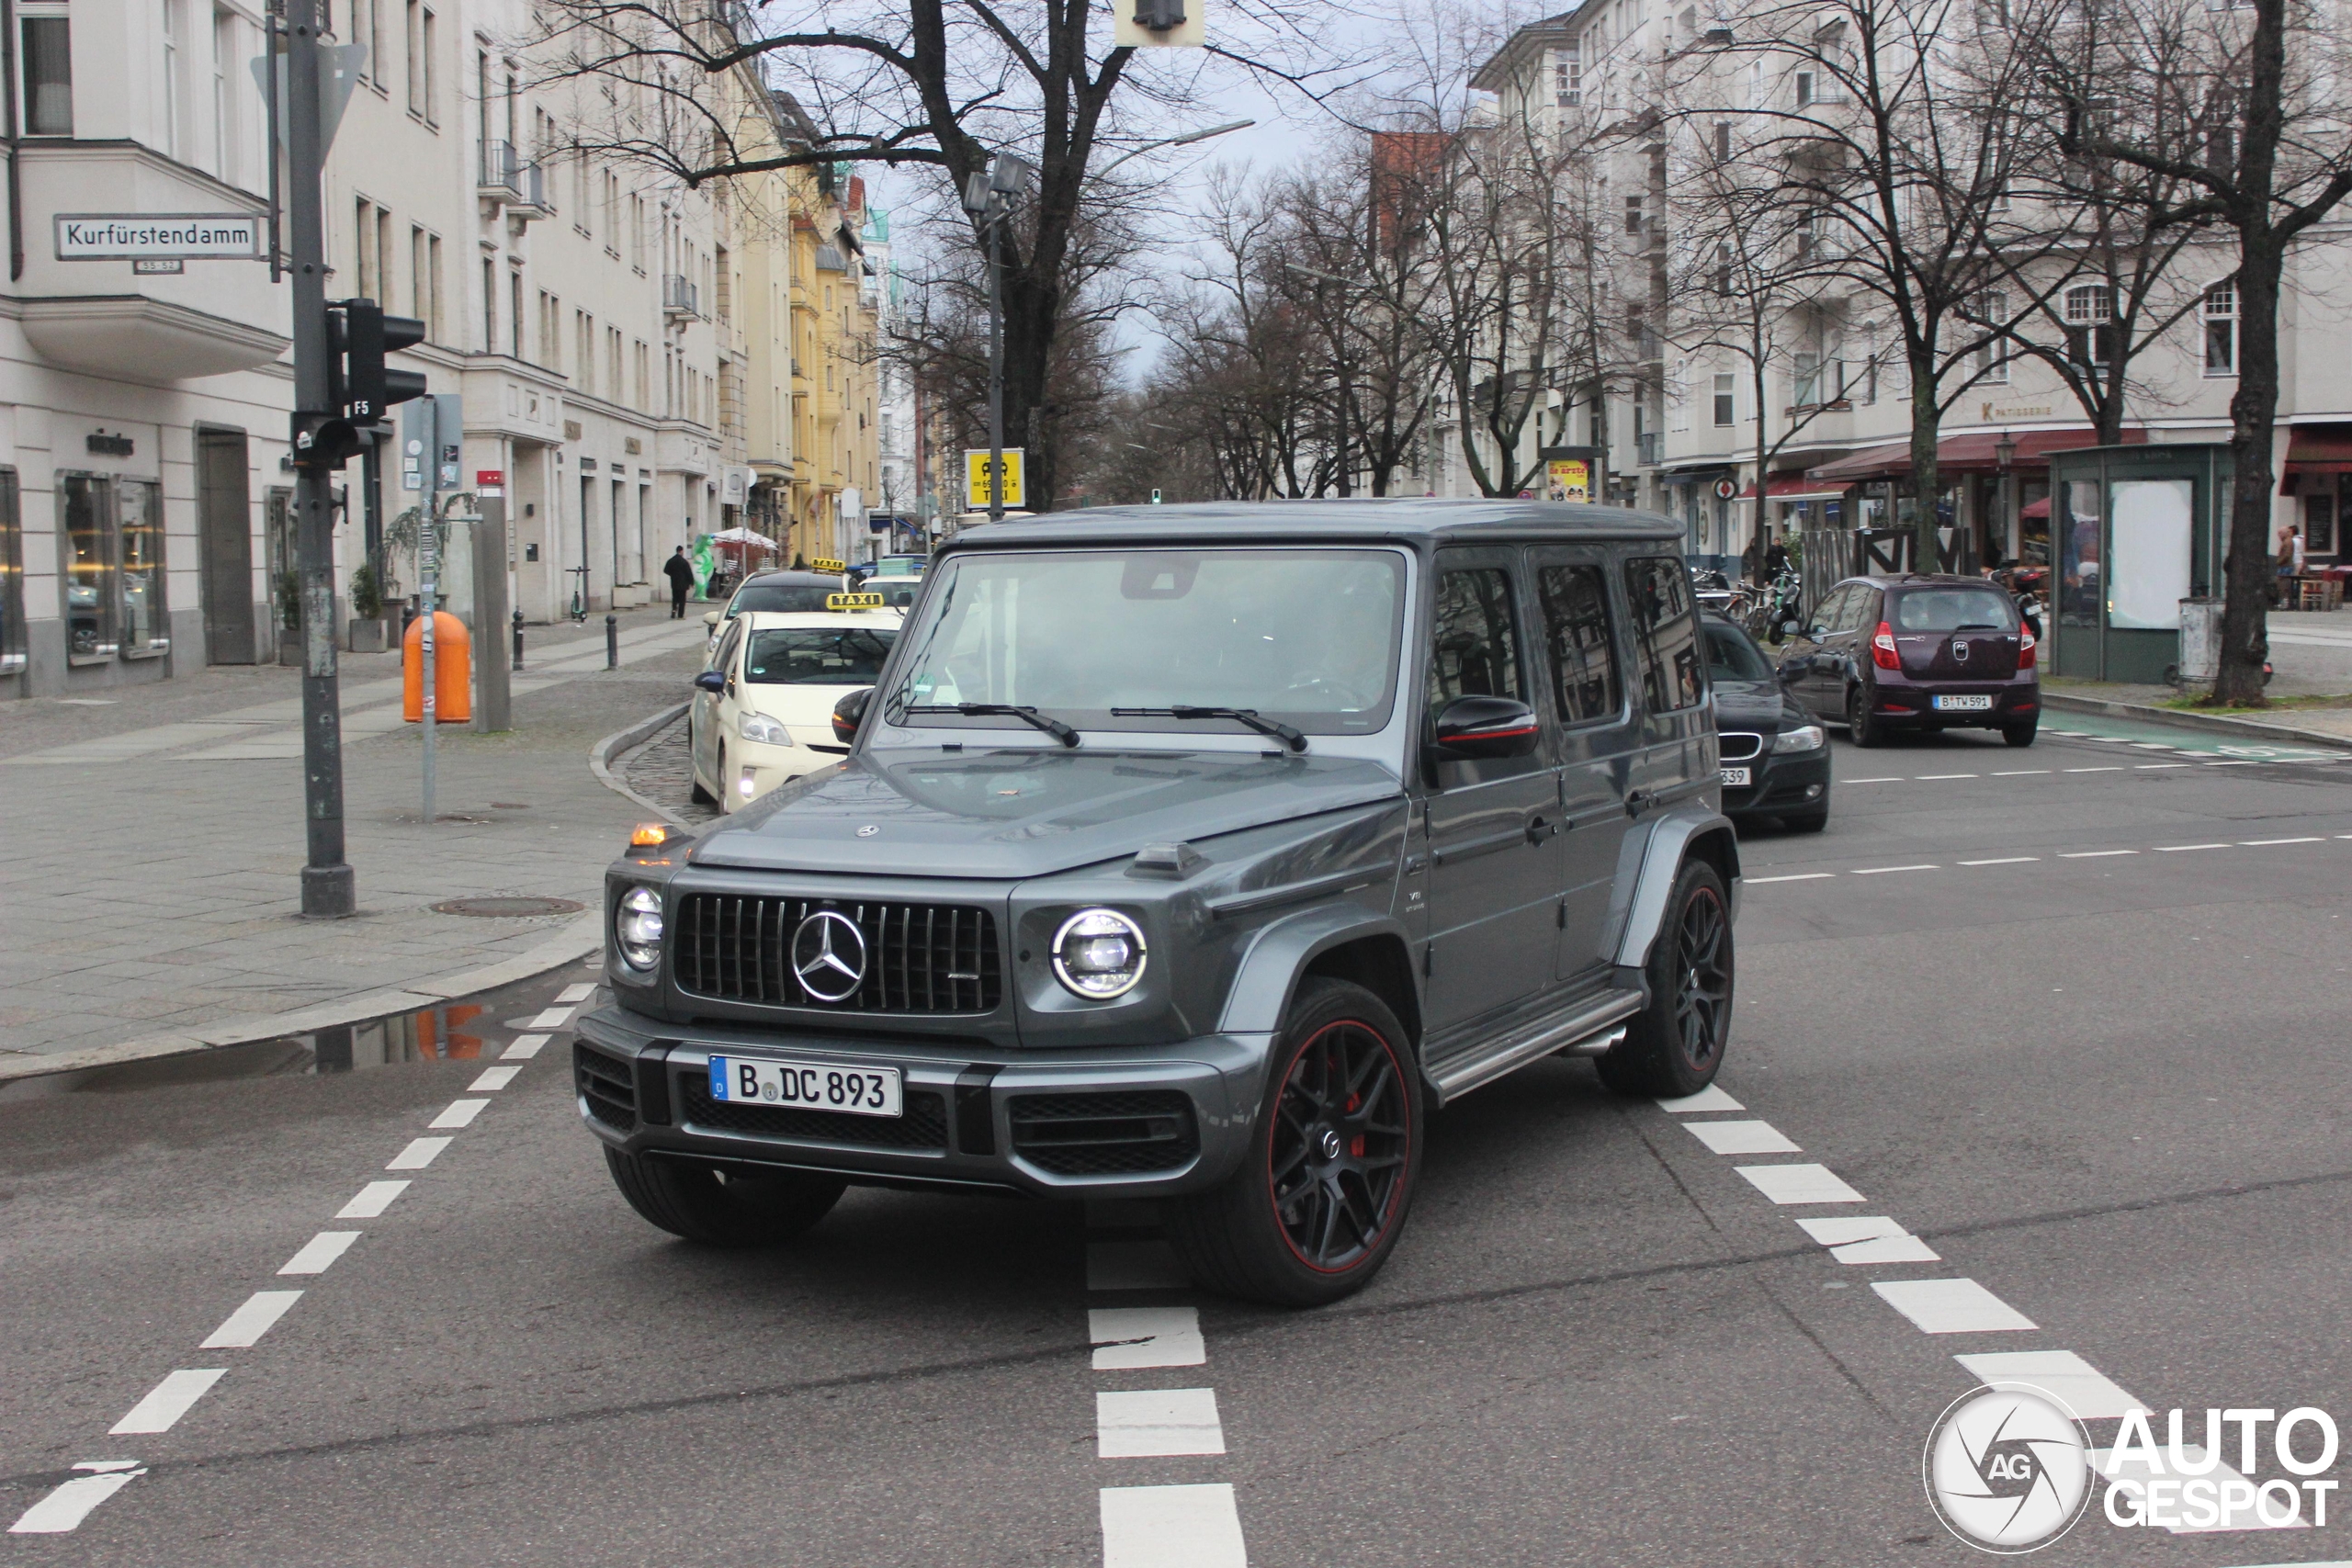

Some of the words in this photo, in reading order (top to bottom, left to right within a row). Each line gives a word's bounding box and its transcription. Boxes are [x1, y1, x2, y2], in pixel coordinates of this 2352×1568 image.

[68, 223, 249, 245] Kurfürstendamm
[354, 400, 369, 415] F5
[983, 490, 1008, 501] TI
[816, 558, 840, 568] TAXI
[837, 595, 875, 604] TAXI
[1942, 697, 1949, 706] B
[1955, 697, 1968, 706] TW
[1969, 696, 1987, 706] 591
[739, 1064, 759, 1098] B
[779, 1067, 820, 1102] DC
[827, 1071, 885, 1108] 893
